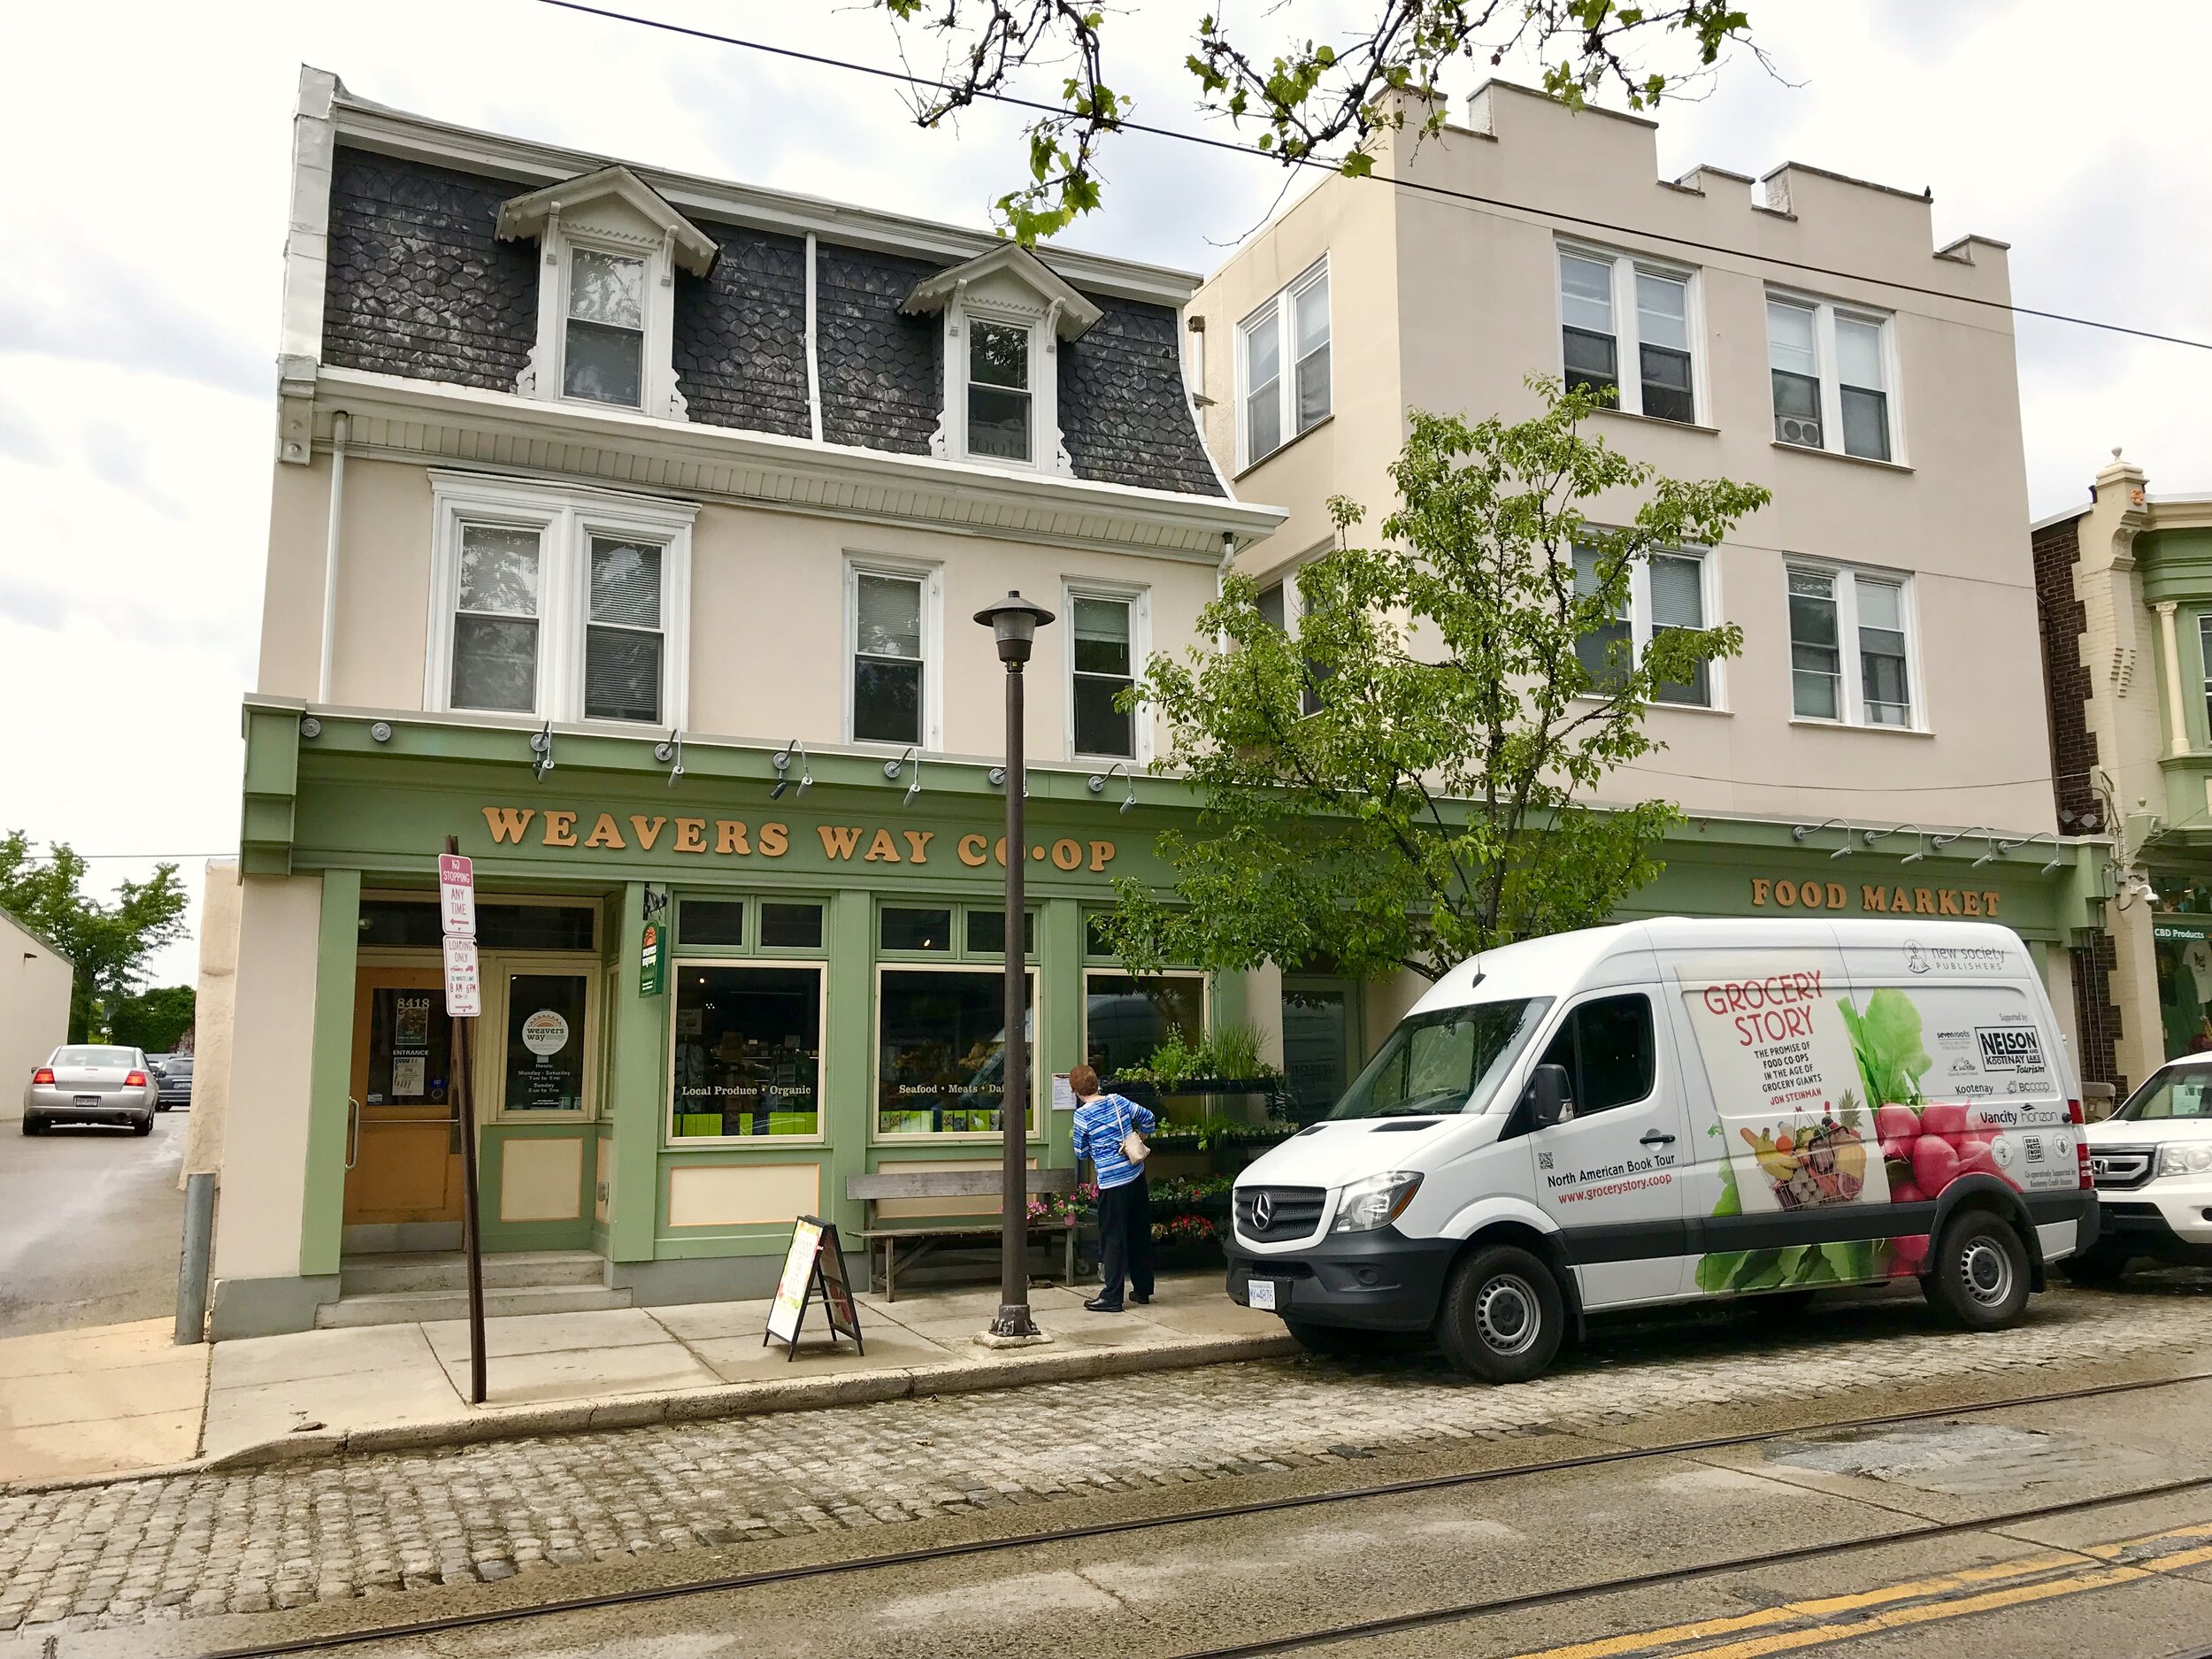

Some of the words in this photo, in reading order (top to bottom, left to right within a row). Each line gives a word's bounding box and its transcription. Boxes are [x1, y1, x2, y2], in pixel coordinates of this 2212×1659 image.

[482, 807, 789, 857] WEAVERS
[817, 826, 934, 864] WAY
[451, 859, 460, 870] NO
[443, 871, 470, 883] STOPPING
[451, 888, 465, 901] ANY
[1752, 878, 1847, 910] FOOD
[1862, 885, 2000, 917] MARKET
[451, 902, 466, 915] TIME
[2154, 928, 2171, 937] CBD
[2172, 930, 2205, 939] Products
[449, 940, 472, 951] LOADING
[454, 952, 468, 963] ONLY
[1932, 948, 1956, 959] new
[1961, 946, 2004, 964] society
[1935, 962, 2002, 971] PUBLISHERS
[1704, 970, 1823, 1015] GROCERY
[397, 998, 430, 1009] 8418
[2000, 1013, 2021, 1023] Supported
[1735, 1005, 1814, 1046] STORY
[1754, 1049, 1770, 1059] THE
[1770, 1043, 1801, 1056] PROMISE
[1801, 1041, 1810, 1050] OF
[1980, 1032, 2037, 1055] NELSON
[1763, 1057, 1783, 1069] FOOD
[1784, 1053, 1809, 1065] CO-OPS
[1985, 1056, 2024, 1065] KOOTENAY
[2026, 1055, 2041, 1064] LAKE
[1763, 1071, 1772, 1080] IN
[1772, 1068, 1787, 1079] THE
[1789, 1065, 1803, 1076] AGE
[1804, 1064, 1813, 1072] OF
[2016, 1064, 2045, 1074] Tourism
[899, 1084, 938, 1094] Seafood
[948, 1085, 978, 1094] Meats
[988, 1084, 1005, 1094] Dai
[1763, 1079, 1794, 1093] GROCERY
[1796, 1073, 1822, 1087] GIANTS
[1955, 1085, 1993, 1094] Kootenay
[682, 1086, 711, 1095] Local
[714, 1086, 757, 1095] Produce
[770, 1085, 811, 1096] Organic
[1770, 1095, 1785, 1105] JON
[1786, 1087, 1823, 1102] STEINMAN
[1980, 1110, 2017, 1125] Vancity
[1547, 1172, 1576, 1187] North
[1579, 1164, 1624, 1182] American
[1627, 1157, 1652, 1172] Book
[1654, 1154, 1675, 1167] Tour
[1558, 1173, 1672, 1204] www.grocerystory.coop
